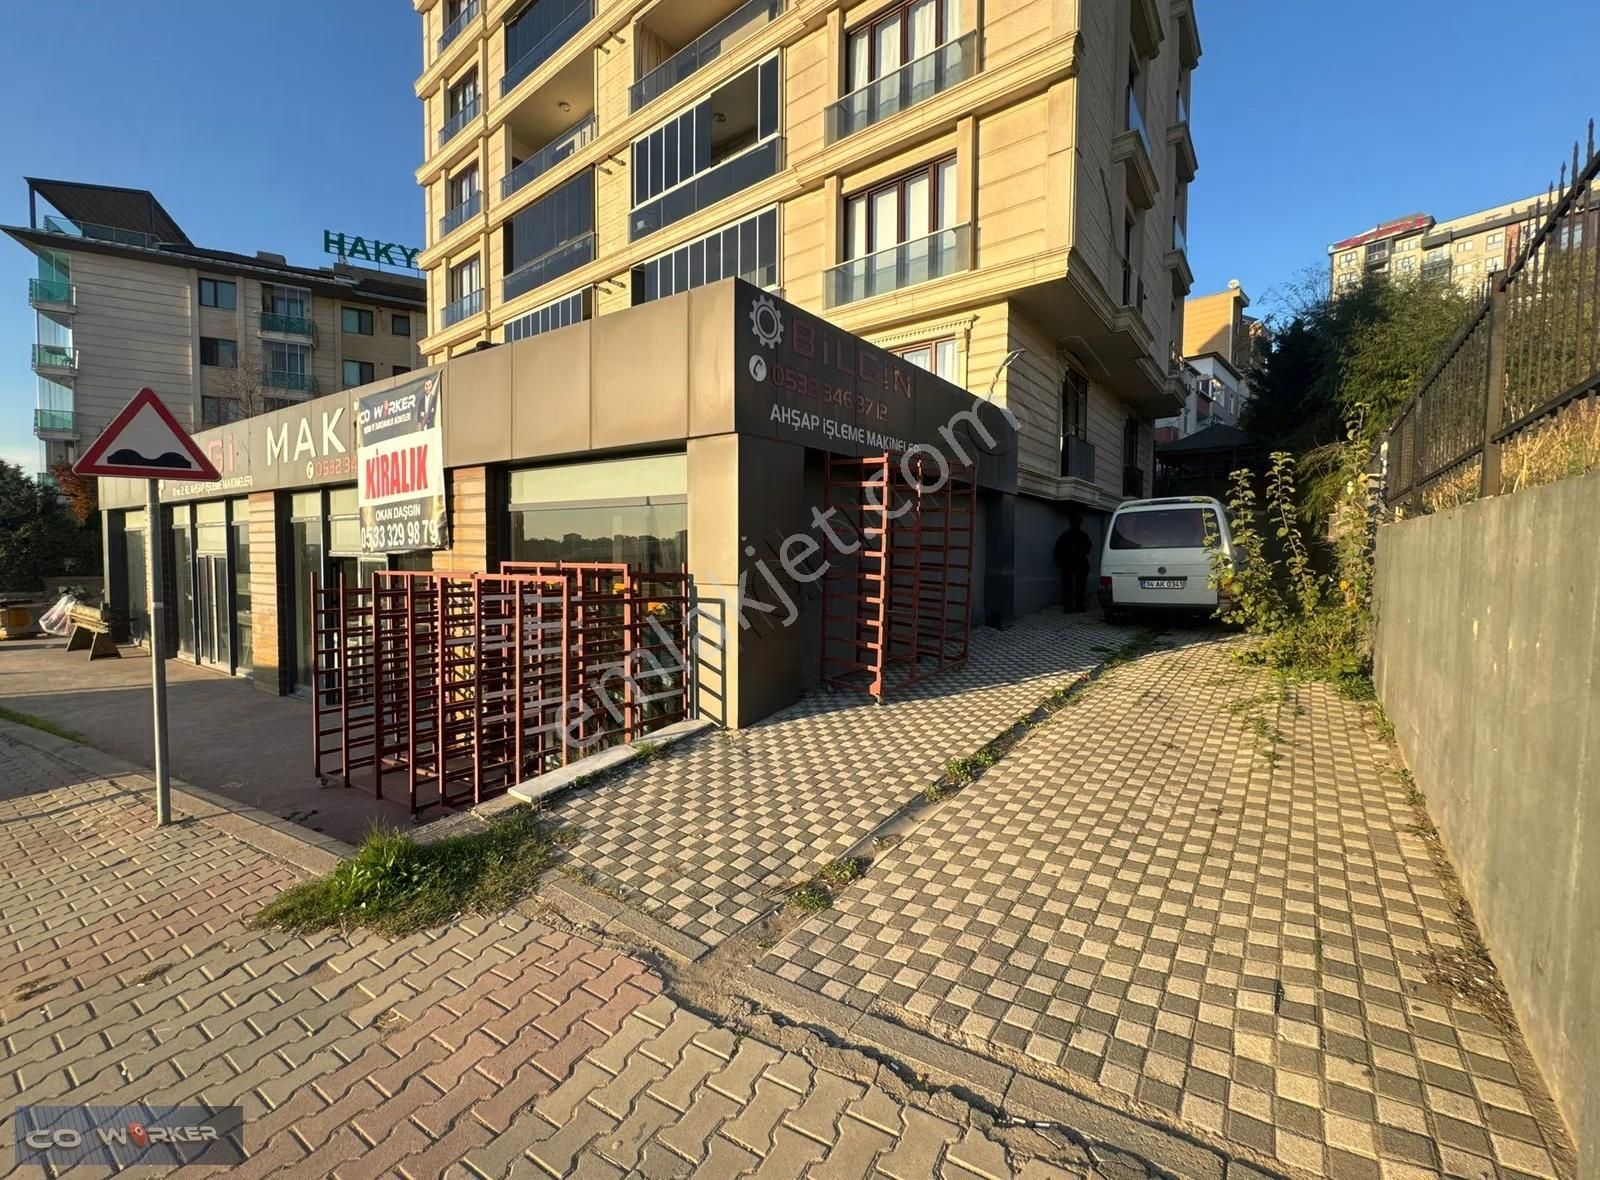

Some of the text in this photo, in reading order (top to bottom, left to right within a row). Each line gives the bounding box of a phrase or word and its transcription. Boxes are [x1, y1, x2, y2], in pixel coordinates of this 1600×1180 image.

[771, 364, 818, 397] 0532
[823, 384, 852, 409] 346
[266, 407, 347, 467] MAK
[770, 403, 820, 431] AHŞAP
[822, 418, 865, 443] İŞLEME
[316, 455, 358, 477] 0532 34
[365, 444, 429, 500] KİRALIK
[375, 504, 421, 522] OKAN DAŞGIN
[361, 525, 386, 549] 0533
[387, 522, 405, 547] 329
[407, 521, 420, 545] 98
